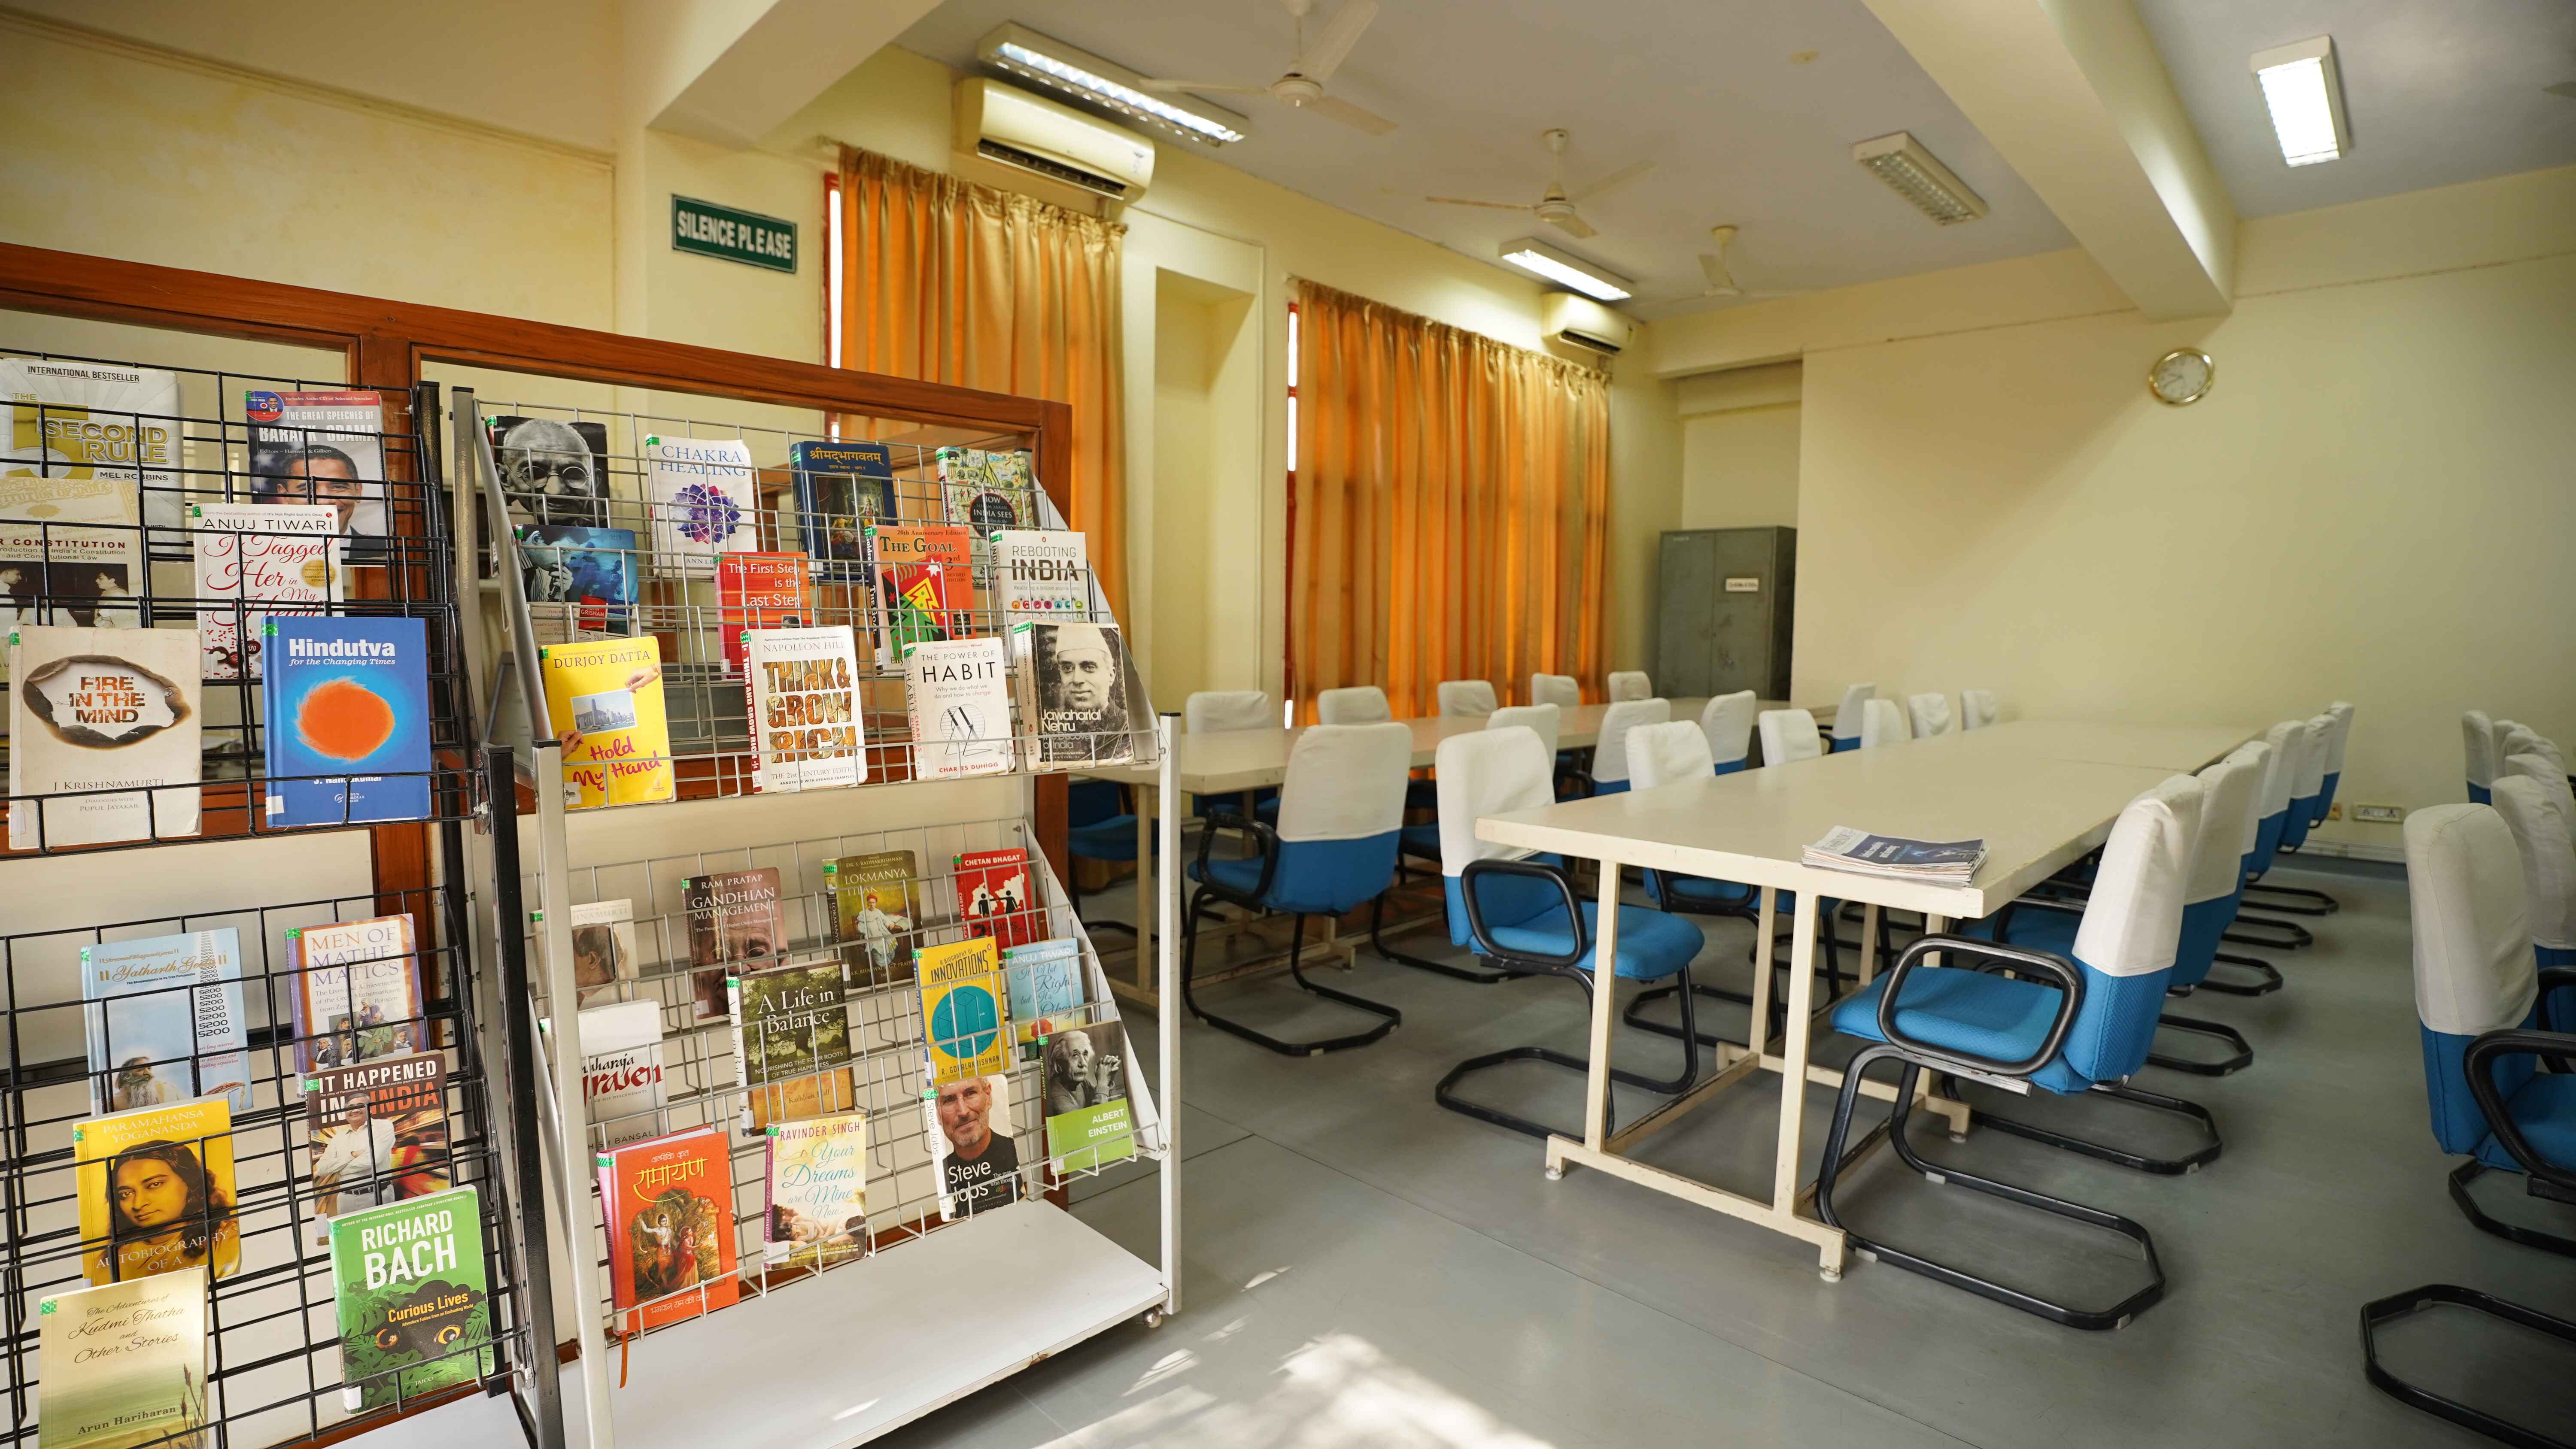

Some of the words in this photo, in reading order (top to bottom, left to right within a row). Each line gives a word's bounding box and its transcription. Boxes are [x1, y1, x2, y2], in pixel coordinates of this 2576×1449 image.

[677, 210, 735, 247] SILENCE
[738, 224, 791, 259] PLEASE
[28, 366, 90, 378] INTERNATIONAL
[92, 372, 140, 382] BESTSELLER
[12, 392, 37, 401] THE
[286, 411, 299, 420] THE
[302, 411, 324, 420] GREAT
[327, 411, 363, 420] SPEECHES
[366, 411, 374, 420] OF
[42, 418, 169, 445] SECOND
[84, 440, 168, 464] RULE
[662, 446, 742, 462] CHAKRA
[660, 461, 746, 476] HEALING
[203, 519, 255, 530] ANUJ
[264, 520, 331, 530] TIWARI
[13, 539, 126, 549] CONSTITUTION
[241, 535, 335, 564] Tagged
[880, 536, 910, 552] THE
[1012, 546, 1077, 558] REBOOTING
[728, 564, 747, 574] The
[750, 563, 775, 574] First
[778, 563, 800, 574] Step
[1012, 559, 1079, 581] INDIA
[775, 578, 782, 588] is
[281, 587, 318, 602] My
[773, 594, 802, 608] Step
[289, 639, 395, 657] Hindutva
[763, 643, 820, 652] NAPOLEON
[944, 651, 978, 660] POWER
[289, 658, 303, 667] for
[323, 658, 367, 667] Changing
[554, 655, 605, 668] DURJOY
[610, 651, 650, 664] DATTA
[762, 658, 836, 694] THINK
[836, 657, 851, 689] &
[923, 662, 996, 683] HABIT
[80, 676, 134, 691] FIRE
[906, 672, 916, 712] HABIT
[69, 693, 92, 707] IN
[96, 692, 145, 706] THE
[76, 709, 139, 723] MIND
[766, 691, 852, 728] GROW
[1041, 709, 1102, 721] Jawaharlal
[1042, 720, 1075, 731] Nehru
[590, 736, 635, 761] Hold
[769, 725, 857, 764] RICH
[1053, 740, 1074, 749] India
[611, 750, 662, 779] Hand
[799, 769, 829, 777] CENTURY
[64, 779, 164, 790] KRISHNAMURTI
[860, 856, 903, 866] RADHAKRISHNAN
[965, 856, 991, 866] CHETAN
[993, 854, 1021, 864] BHAGAT
[702, 880, 723, 889] RAM
[728, 874, 763, 886] PRATAP
[844, 868, 907, 885] LOKMANYA
[692, 887, 775, 909] GANDHIAN
[694, 900, 776, 921] MANAGEMENT
[311, 931, 361, 951] MEN
[368, 927, 395, 943] OF
[944, 950, 967, 964] BIOGRAPHY
[1012, 952, 1037, 964] ANUJ
[1039, 947, 1073, 959] TIWARI
[112, 960, 177, 982] Yatharth
[314, 961, 399, 986] MATICS
[931, 949, 989, 983] INNOVATIONS
[354, 987, 402, 999] Mathematicians
[757, 994, 776, 1014] A
[781, 986, 814, 1009] Life
[820, 985, 834, 1003] in
[1021, 994, 1031, 1005] but
[199, 1005, 225, 1013] 5200
[199, 1012, 226, 1021] 5200
[199, 1019, 228, 1029] 5200
[766, 1010, 830, 1034] Balance
[198, 1027, 230, 1038] 5200
[755, 1061, 793, 1074] NOURISHING
[824, 1051, 844, 1060] ROOTS
[319, 1076, 335, 1094] IT
[343, 1060, 437, 1090] HAPPENED
[370, 1082, 438, 1115] INDIA
[613, 1090, 647, 1099] DESCENDANTS
[789, 1094, 815, 1104] Kathleen
[103, 1109, 204, 1134] PARAMAHANSA
[927, 1102, 936, 1129] Steve
[1092, 1108, 1124, 1124] ALBERT
[112, 1121, 198, 1143] YOGANANDA
[614, 1131, 654, 1144] BANSAL
[781, 1126, 827, 1141] RAVINDER
[832, 1122, 860, 1135] SINGH
[1088, 1121, 1127, 1138] EINSTEIN
[930, 1133, 939, 1155] Jobs
[811, 1140, 854, 1168] Your
[633, 1157, 708, 1202] रामायण
[781, 1162, 857, 1188] Dreams
[948, 1161, 991, 1184] Steve
[787, 1195, 802, 1204] are
[805, 1185, 853, 1205] Mine
[954, 1181, 989, 1204] Jobs
[361, 1210, 452, 1251] RICHARD
[148, 1258, 168, 1271] OF
[364, 1234, 457, 1290] BACH
[106, 1297, 159, 1313] Adventures
[388, 1302, 434, 1322] Curious
[437, 1293, 468, 1310] Lives
[68, 1317, 129, 1340] Kudmi
[132, 1307, 185, 1325] Thatha
[119, 1330, 138, 1340] and
[74, 1346, 123, 1363] Other
[126, 1332, 180, 1352] Stories
[415, 1376, 434, 1387] JAICO
[78, 1421, 109, 1434] Arun
[114, 1406, 176, 1426] Hariharan
